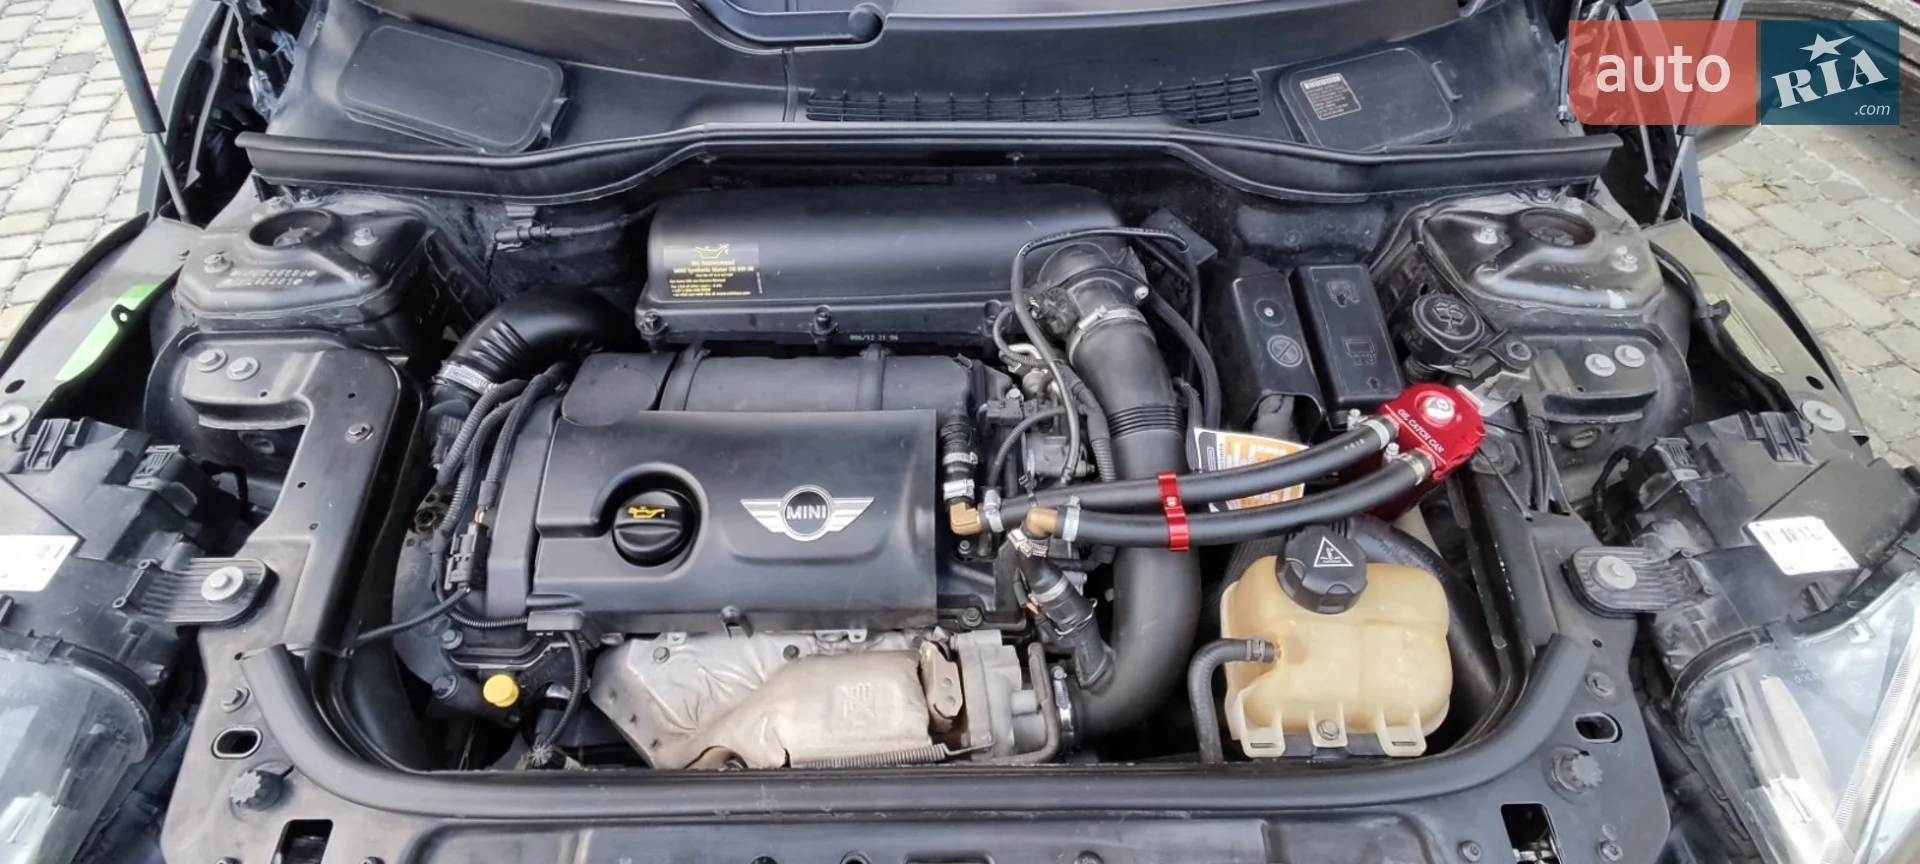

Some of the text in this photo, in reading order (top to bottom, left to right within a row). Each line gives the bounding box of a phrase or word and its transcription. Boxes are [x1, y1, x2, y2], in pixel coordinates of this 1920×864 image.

[1398, 408, 1445, 453] OIL CATCH CAN
[786, 505, 827, 520] MINI
